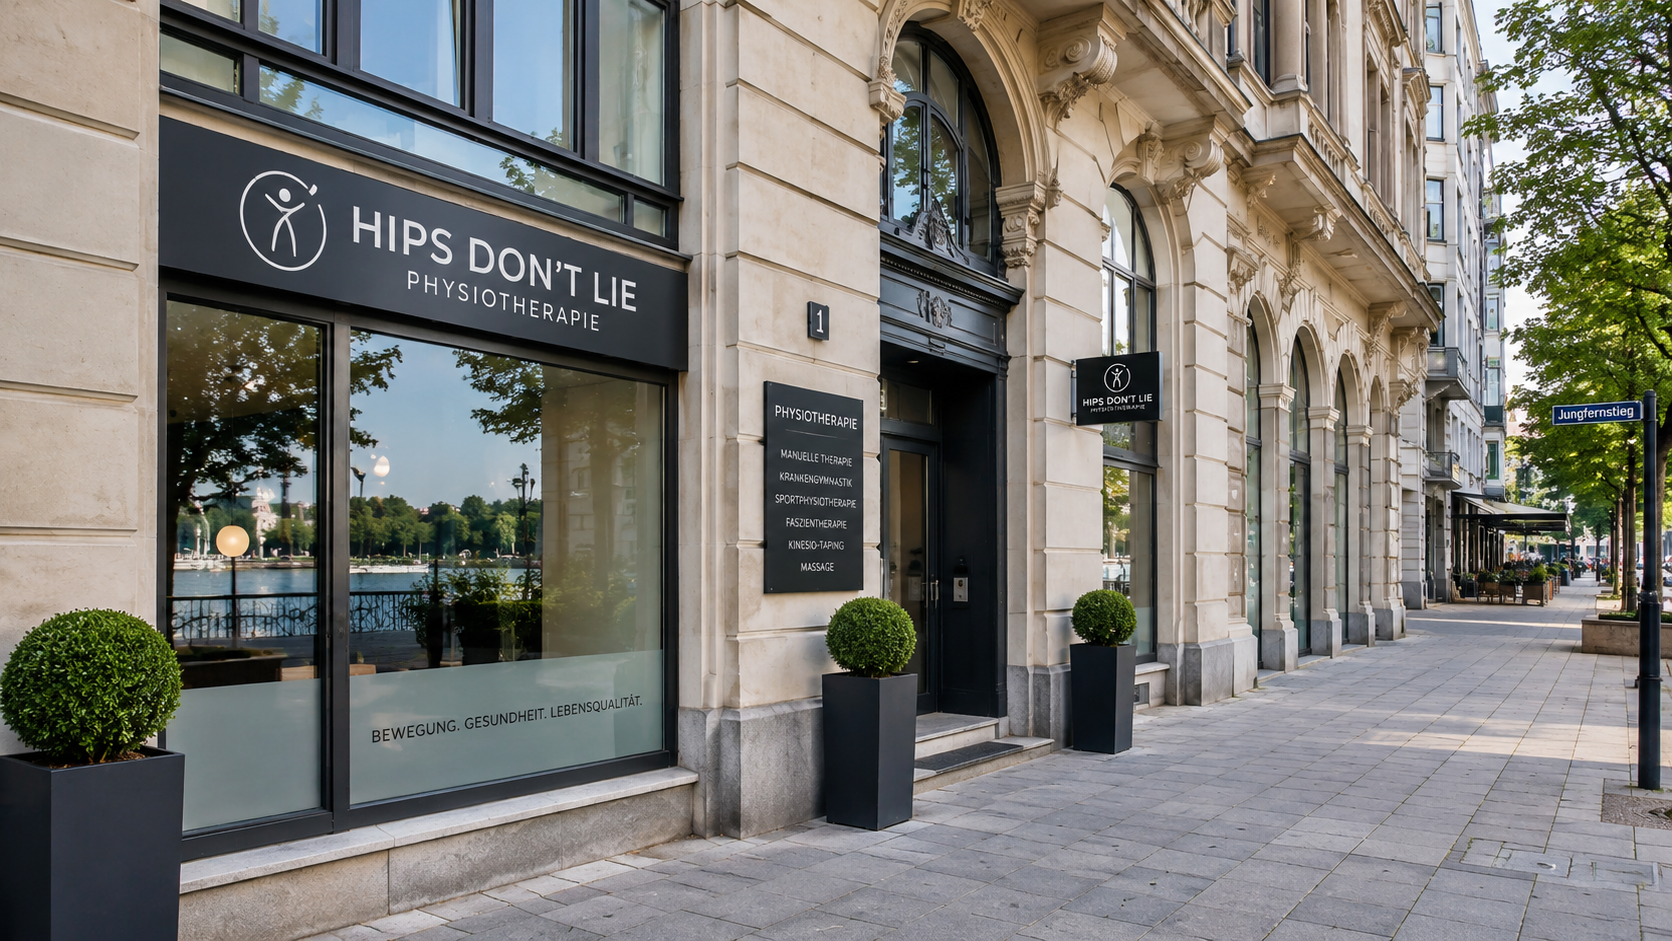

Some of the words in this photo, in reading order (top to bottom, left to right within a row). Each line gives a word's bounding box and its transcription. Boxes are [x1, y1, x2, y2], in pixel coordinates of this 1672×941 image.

[352, 206, 453, 265] HIPS
[468, 238, 581, 297] DON'T
[593, 272, 637, 313] LIE
[407, 269, 600, 333] PHYSIOTHERAPIE
[816, 309, 824, 334] 1
[1082, 398, 1104, 406] HIPS
[1106, 395, 1136, 405] DON'T
[1138, 394, 1153, 402] LIE
[775, 404, 858, 430] PHYSIOTHERAPIE
[1558, 406, 1634, 421] Jungfernstieg
[780, 448, 819, 463] MANUELLE
[820, 453, 853, 467] THERAPIE
[775, 493, 857, 509] SPORTPHYSIOTHERAPIE
[785, 517, 848, 530] FASZIENTHERAPIE
[788, 540, 845, 551] KINESIO-TAPING
[800, 562, 835, 572] MASSAGE
[371, 719, 461, 744] BEWEGUNG.
[464, 707, 548, 731] GESUNDHEIT.
